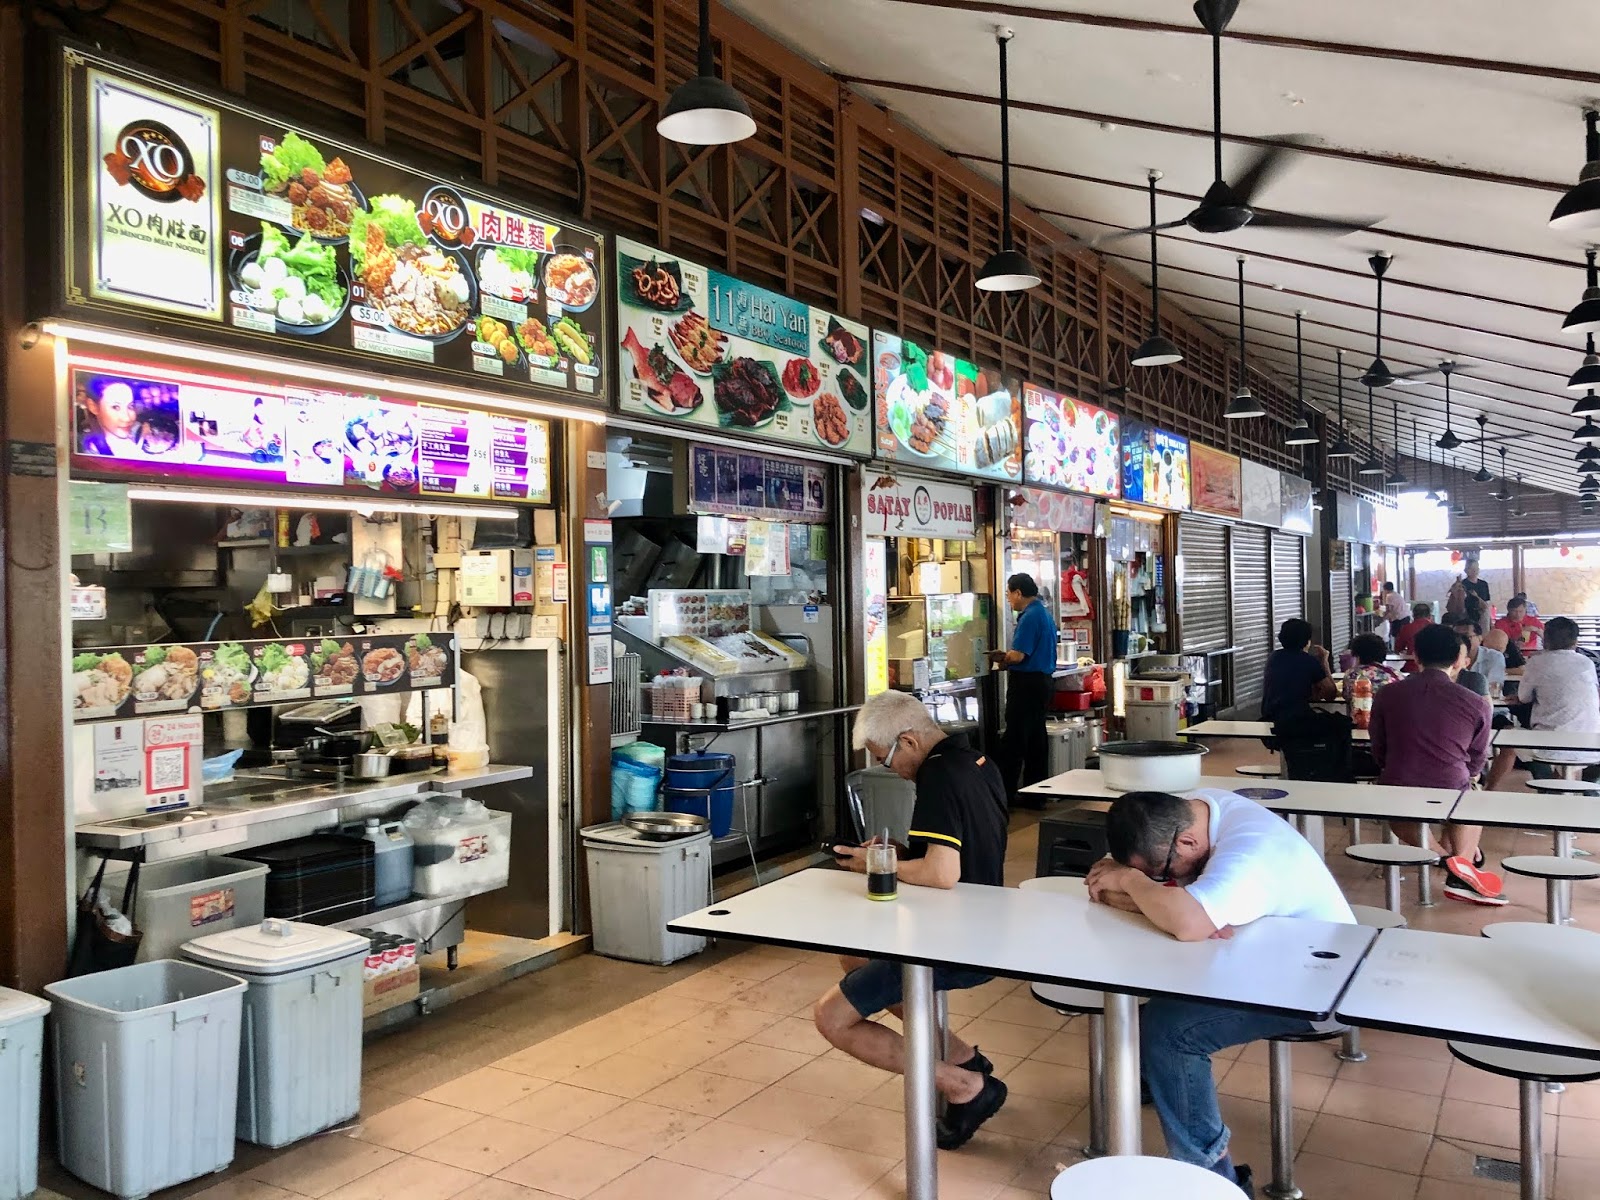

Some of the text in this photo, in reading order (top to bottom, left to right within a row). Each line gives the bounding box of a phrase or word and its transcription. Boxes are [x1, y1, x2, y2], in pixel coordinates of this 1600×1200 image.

[261, 140, 273, 152] 03
[121, 136, 184, 184] XO
[107, 202, 143, 228] XO
[427, 199, 465, 235] XO
[120, 229, 152, 242] MINCED
[154, 237, 173, 248] MEAT
[175, 242, 206, 255] NOODLE
[353, 286, 364, 298] 01
[713, 285, 734, 325] 11
[359, 308, 385, 323] $5.00
[751, 295, 776, 325] Hai
[780, 304, 807, 335] Yan
[751, 324, 807, 351] BBQ Seafood
[867, 494, 911, 517] SATAY
[933, 501, 973, 523] POPIAH
